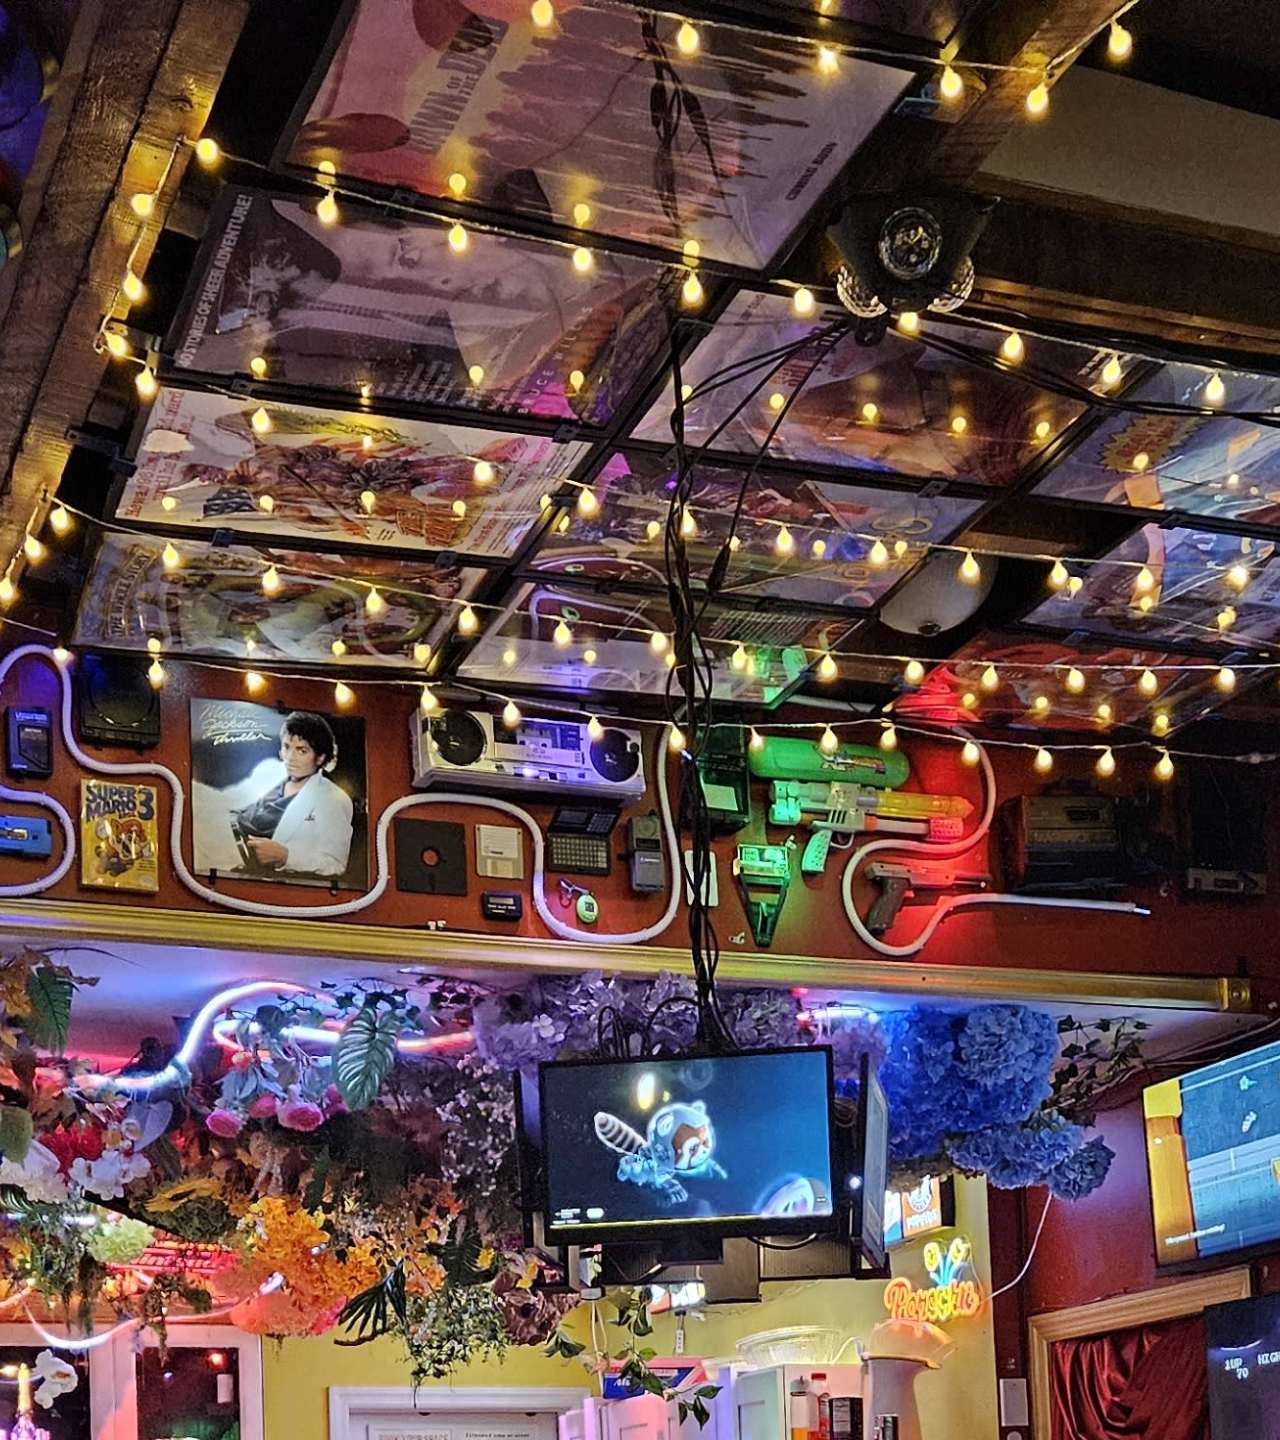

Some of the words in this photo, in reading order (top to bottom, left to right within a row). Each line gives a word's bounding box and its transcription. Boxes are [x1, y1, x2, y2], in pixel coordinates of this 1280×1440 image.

[437, 14, 509, 74] DEAD
[214, 194, 253, 272] ADVENTURE!
[86, 784, 137, 803] SUPER
[138, 788, 154, 820] 3
[86, 800, 137, 822] MARIO
[1225, 1358, 1243, 1371] 1UP
[1236, 1368, 1249, 1379] 70
